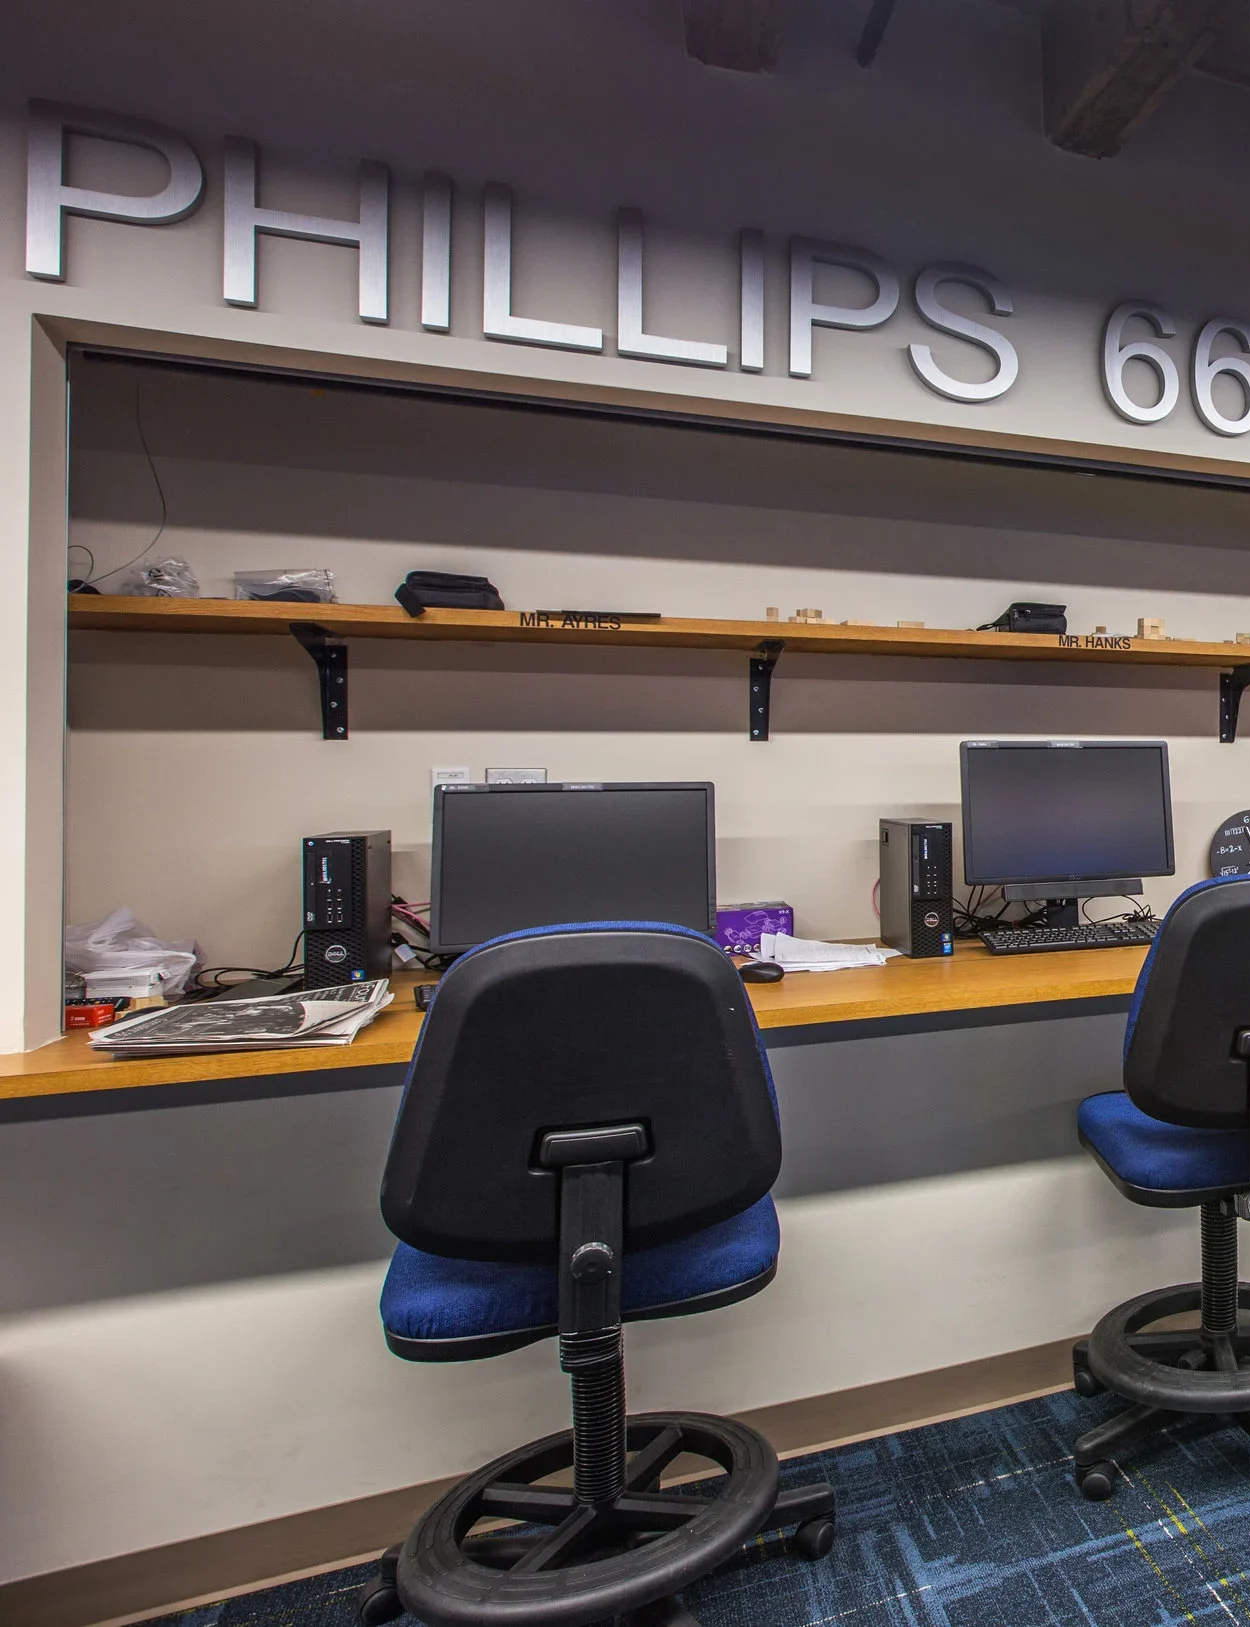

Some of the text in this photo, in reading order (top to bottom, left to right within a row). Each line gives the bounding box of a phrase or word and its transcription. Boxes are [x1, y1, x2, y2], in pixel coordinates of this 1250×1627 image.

[26, 98, 1019, 402] PHILLIPS
[519, 612, 622, 630] MR. AYRES
[1058, 636, 1131, 649] MR. HANKS
